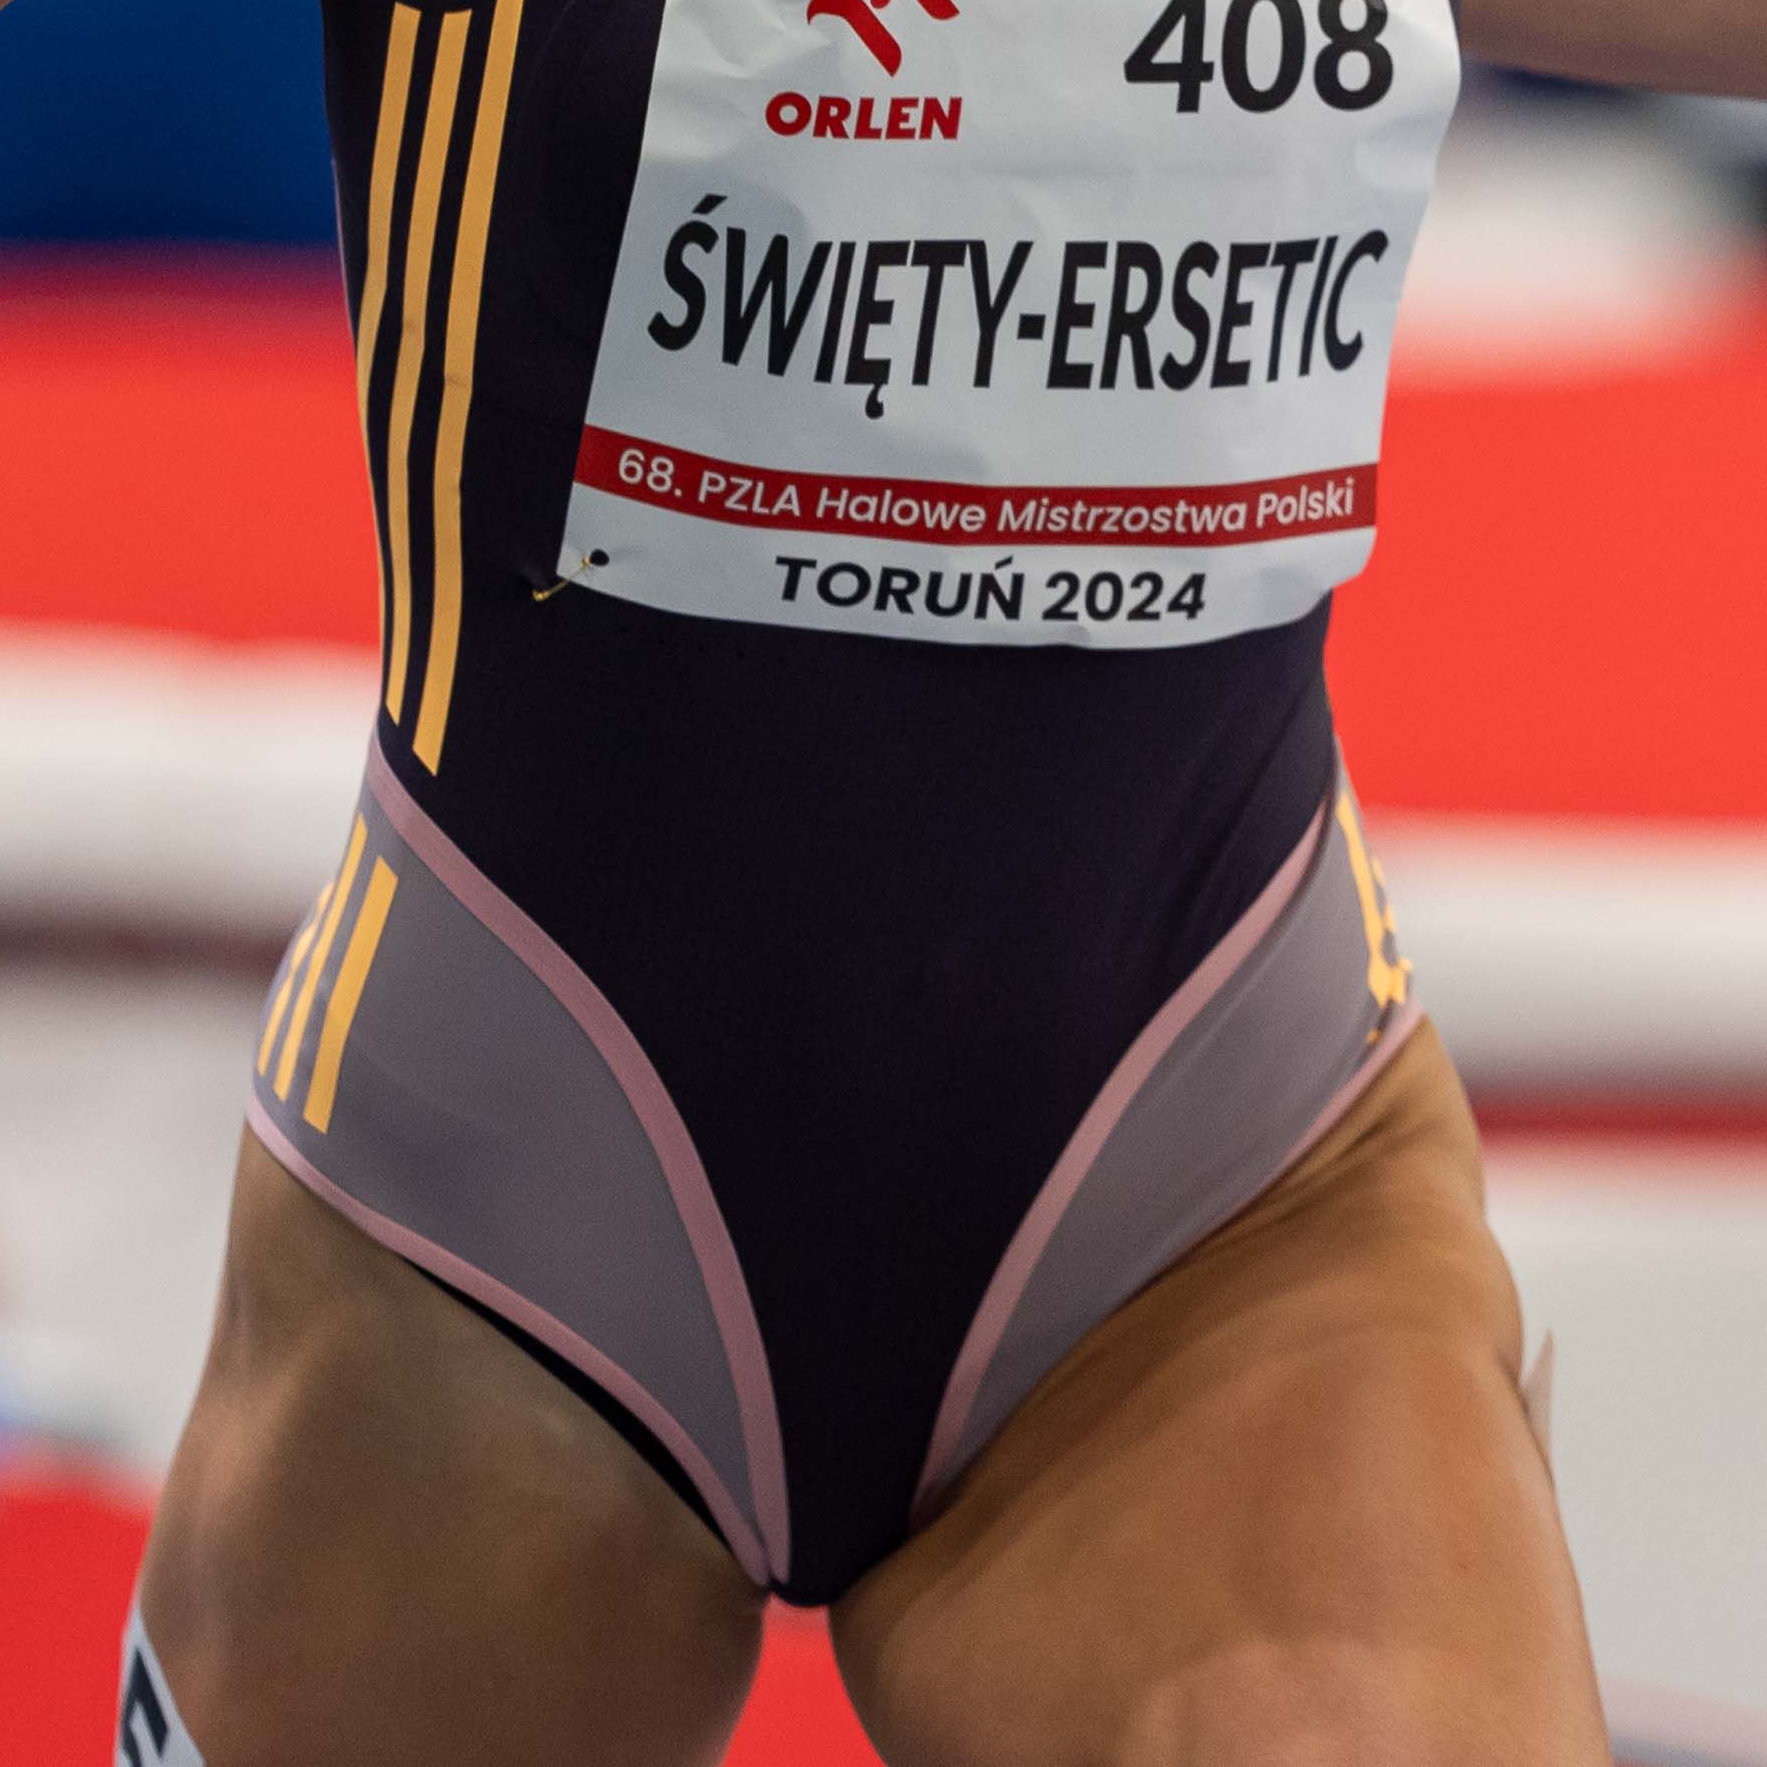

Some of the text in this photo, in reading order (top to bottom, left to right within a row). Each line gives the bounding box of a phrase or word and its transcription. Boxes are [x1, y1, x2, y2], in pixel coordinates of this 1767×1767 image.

[764, 91, 962, 140] ORLEN
[647, 193, 1389, 420] ŚWIĘTY-ERSETIC
[617, 447, 1355, 534] 68. PZLA Halowe Mistrzostwa Polski
[774, 555, 1206, 622] TORUŃ 2024
